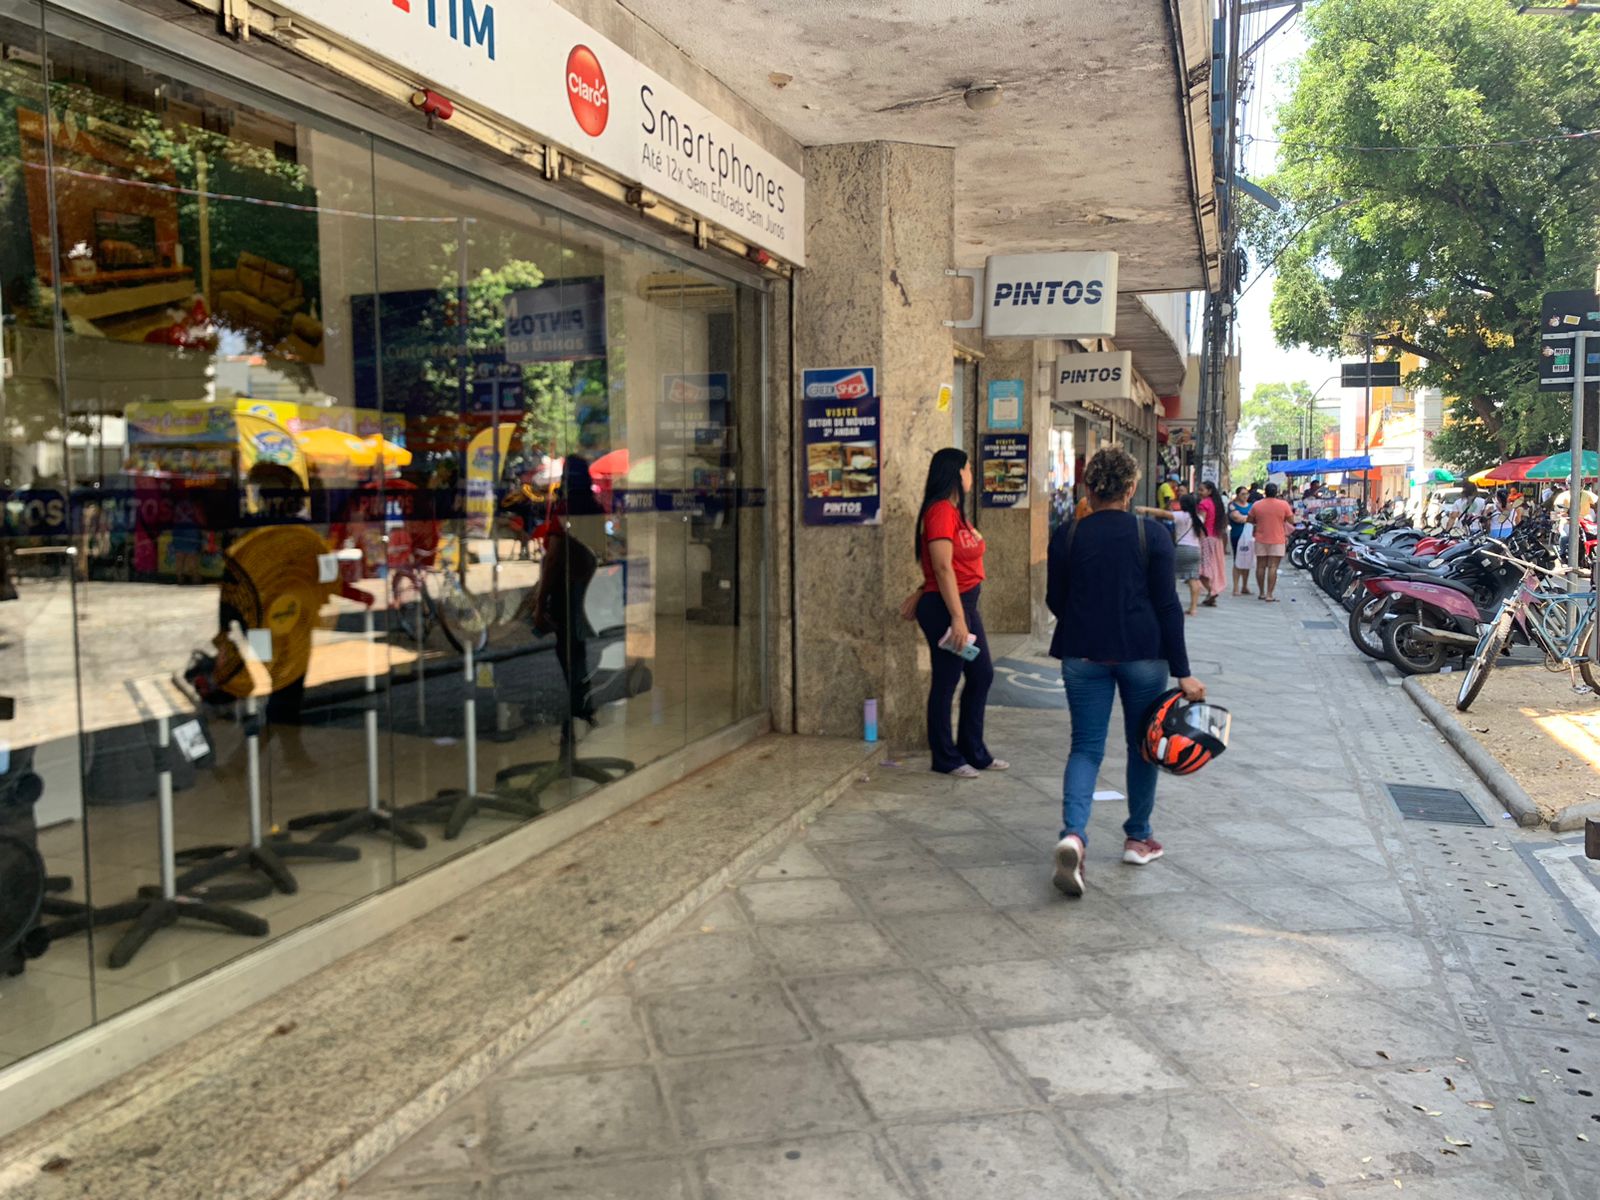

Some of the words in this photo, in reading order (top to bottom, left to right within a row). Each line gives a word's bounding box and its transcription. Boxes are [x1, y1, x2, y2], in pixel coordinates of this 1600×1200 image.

[568, 73, 606, 107] Claro
[640, 84, 785, 213] Smartphones
[642, 143, 663, 173] Até
[666, 155, 684, 185] 12x
[687, 168, 708, 199] Sem
[711, 181, 745, 218] Entrada
[746, 202, 764, 228] Sem
[765, 214, 785, 241] Juros
[993, 280, 1104, 307] PINTOS
[1060, 367, 1122, 384] PINTOS
[825, 407, 859, 418] VISITE
[834, 417, 845, 427] DE
[823, 502, 862, 514] PINTOS
